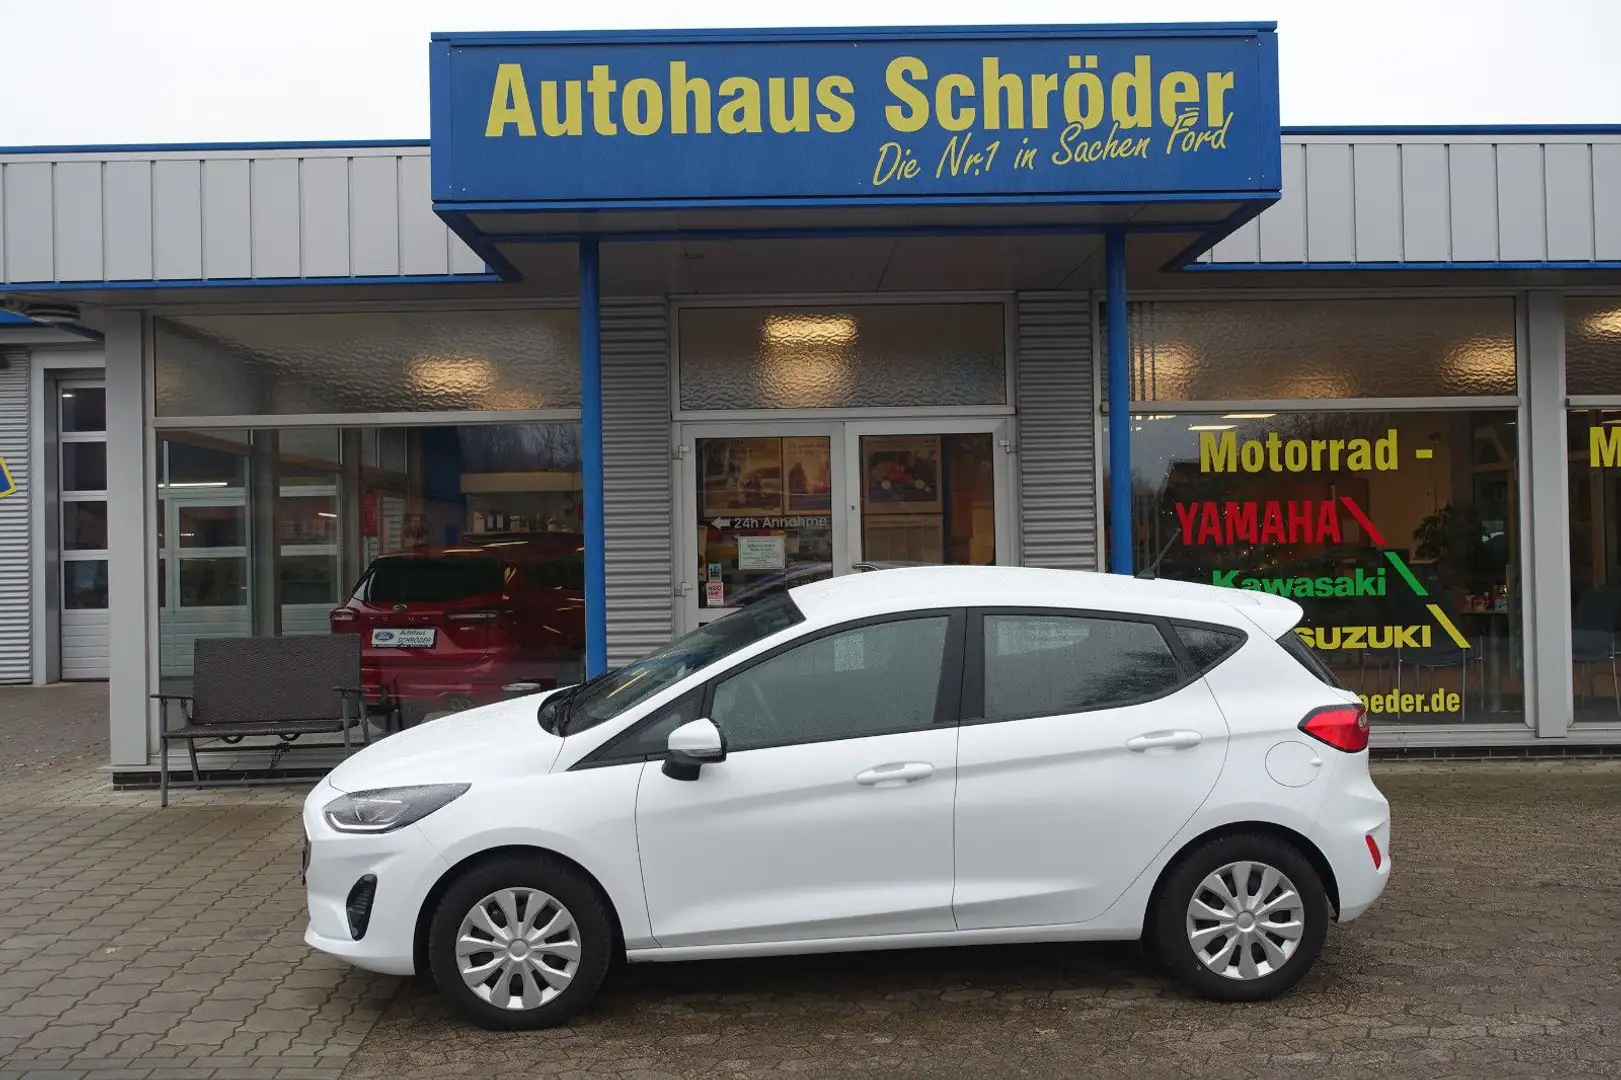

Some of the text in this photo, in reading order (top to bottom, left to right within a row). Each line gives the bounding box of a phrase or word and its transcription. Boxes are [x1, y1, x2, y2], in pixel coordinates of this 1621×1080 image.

[485, 54, 1235, 138] Autohaus Schröder
[872, 142, 921, 187] Die
[1014, 145, 1037, 171] in
[1051, 122, 1150, 167] Sachen
[1165, 107, 1234, 155] Ford
[1199, 429, 1399, 475] Motorrad
[734, 515, 828, 530] 24h Annahme
[1176, 501, 1343, 546] YAMAHA
[1212, 566, 1386, 599] Kawasaki
[1293, 625, 1432, 650] SUZUKI
